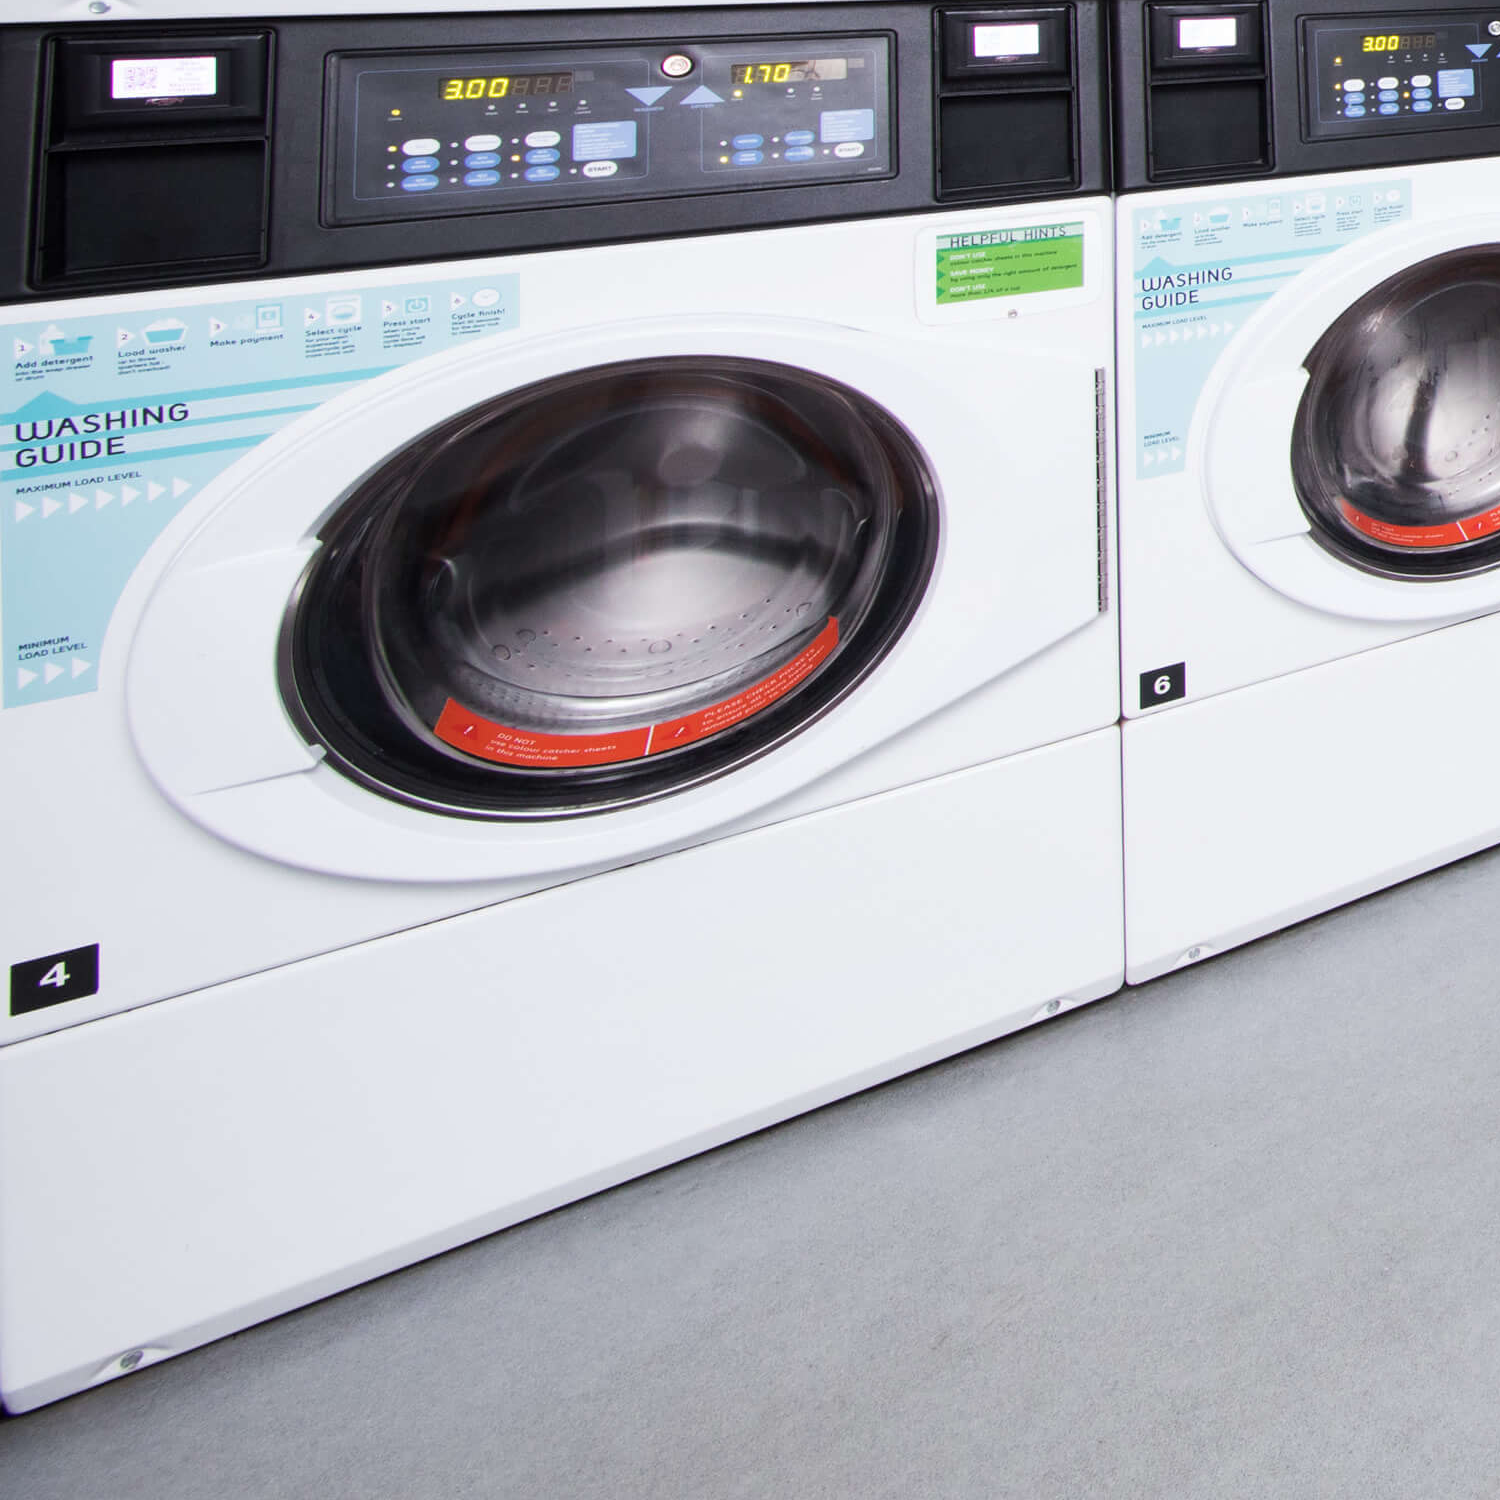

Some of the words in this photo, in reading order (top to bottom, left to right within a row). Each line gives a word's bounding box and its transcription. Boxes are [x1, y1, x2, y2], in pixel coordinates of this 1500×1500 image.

[1362, 35, 1400, 52] 3.00
[744, 64, 791, 84] 1.70
[444, 77, 509, 100] 3.00
[951, 231, 1016, 248] HELPFUL
[1024, 227, 1066, 240] HINTS
[1142, 267, 1233, 292] WASHING
[1142, 289, 1199, 310] GUIDE
[410, 317, 431, 325] start
[452, 312, 475, 321] Cycle
[478, 308, 505, 317] finish!
[305, 328, 335, 336] Select
[338, 325, 362, 335] cycle
[1142, 320, 1171, 329] MAXIMUM
[210, 338, 237, 347] Make
[240, 333, 284, 346] payment
[118, 349, 145, 357] Load
[149, 345, 186, 355] washer
[15, 361, 37, 369] Add
[41, 356, 93, 367] detergent
[16, 403, 189, 442] WASHING
[16, 436, 126, 468] GUIDE
[16, 481, 71, 495] MAXIMUM
[75, 477, 104, 486] LOAD
[108, 471, 142, 482] LEVEL
[18, 635, 70, 651] MINIMUM
[18, 648, 54, 661] LOAD
[57, 641, 88, 655] LEVEL
[1154, 676, 1171, 695] 6
[497, 733, 512, 741] DO
[514, 737, 536, 745] NOT
[39, 961, 70, 987] 4
